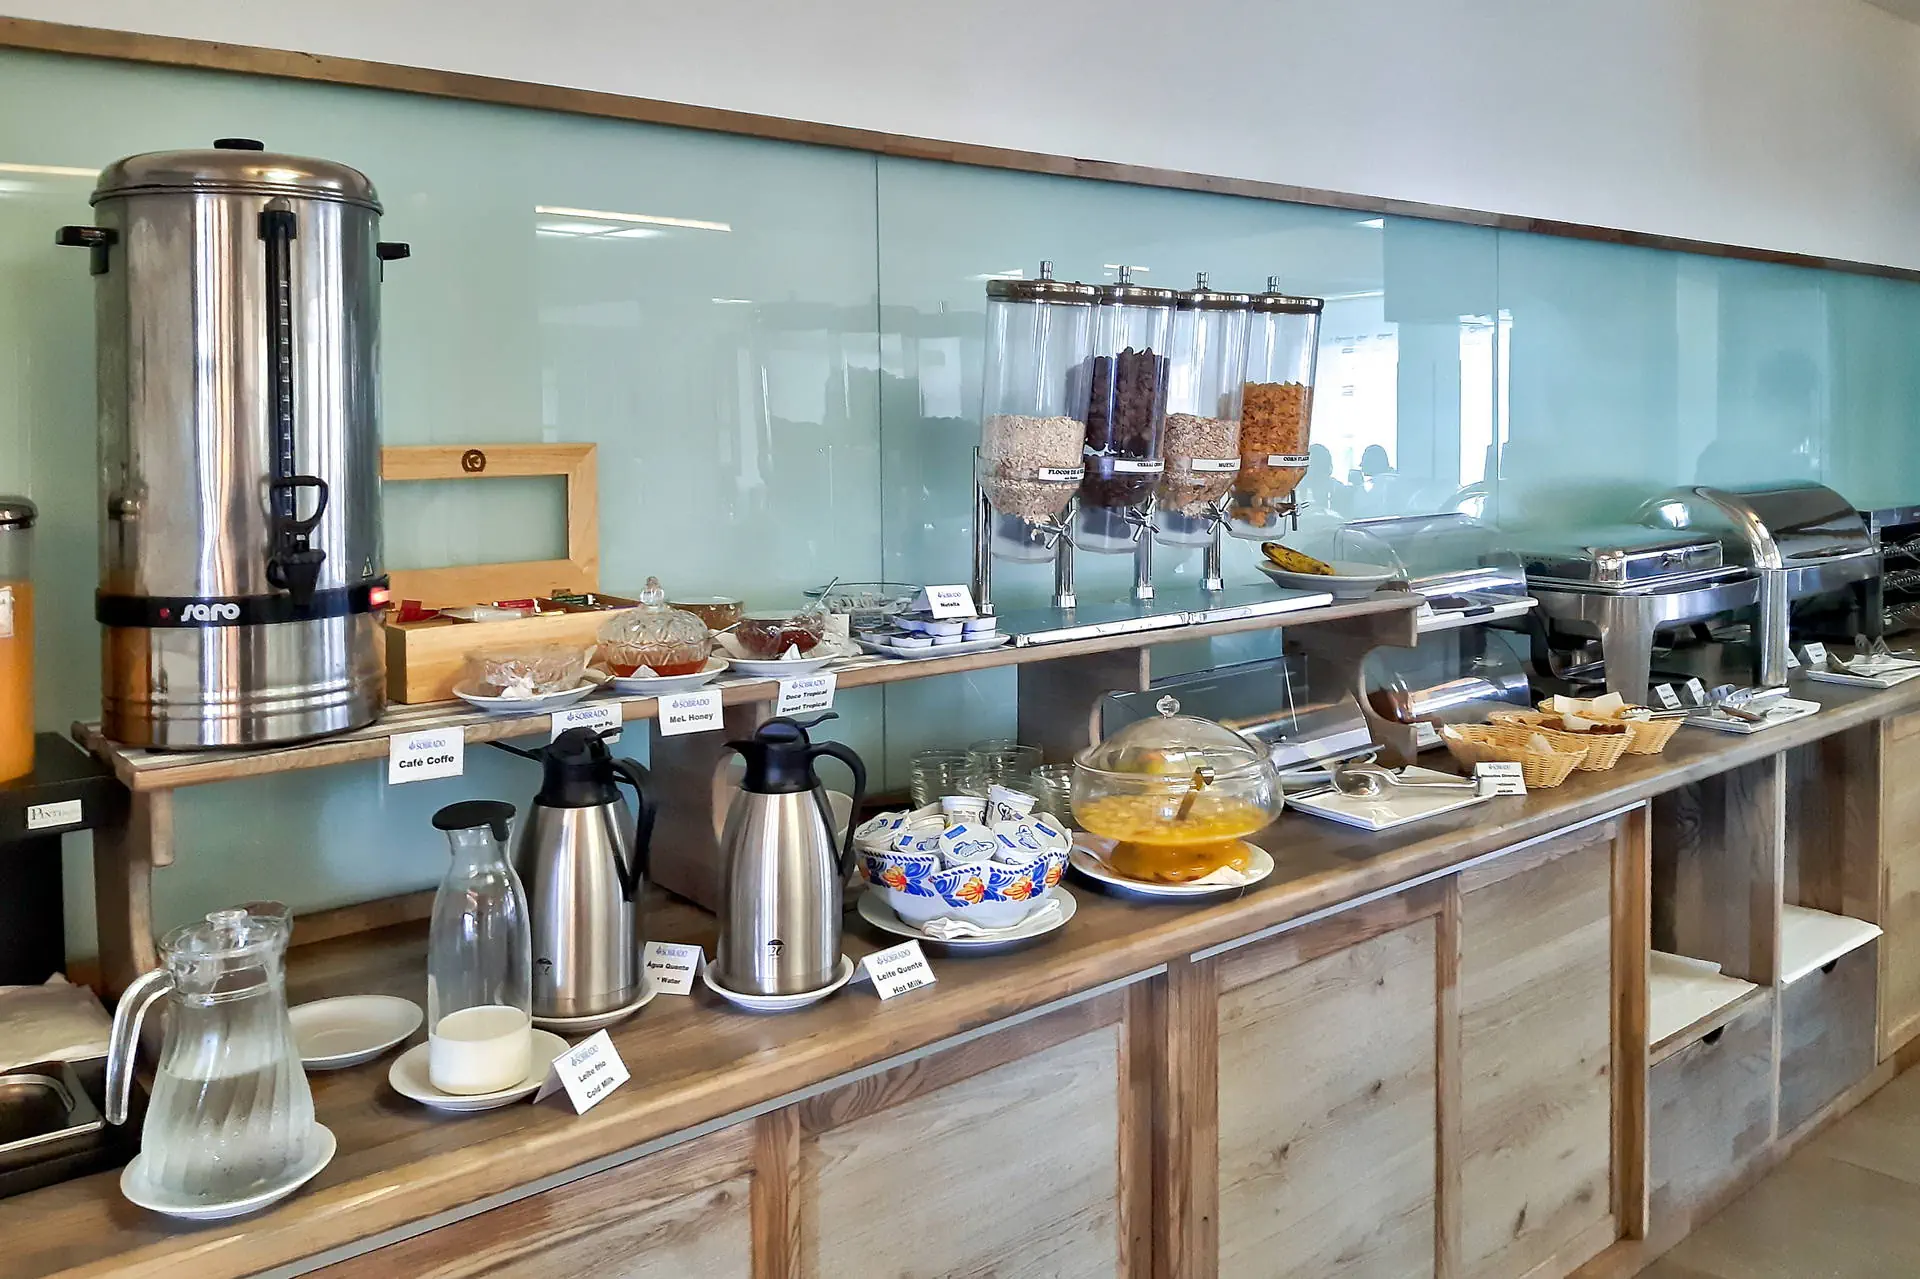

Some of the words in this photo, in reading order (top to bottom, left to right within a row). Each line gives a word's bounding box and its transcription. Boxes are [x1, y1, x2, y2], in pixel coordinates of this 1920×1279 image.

[181, 603, 240, 622] saro
[803, 689, 828, 698] Tropical
[782, 705, 801, 713] Sweet
[803, 700, 828, 709] Tropical
[575, 709, 608, 721] SOBRADO
[688, 712, 714, 722] Honey
[399, 758, 424, 769] Café
[426, 754, 455, 765] Coffe
[665, 963, 690, 971] Quente
[876, 970, 897, 982] Leite
[897, 960, 923, 974] Quente
[892, 984, 907, 994] Hot
[907, 978, 924, 989] Milk
[578, 1067, 596, 1083] Leite
[586, 1083, 602, 1099] Cold
